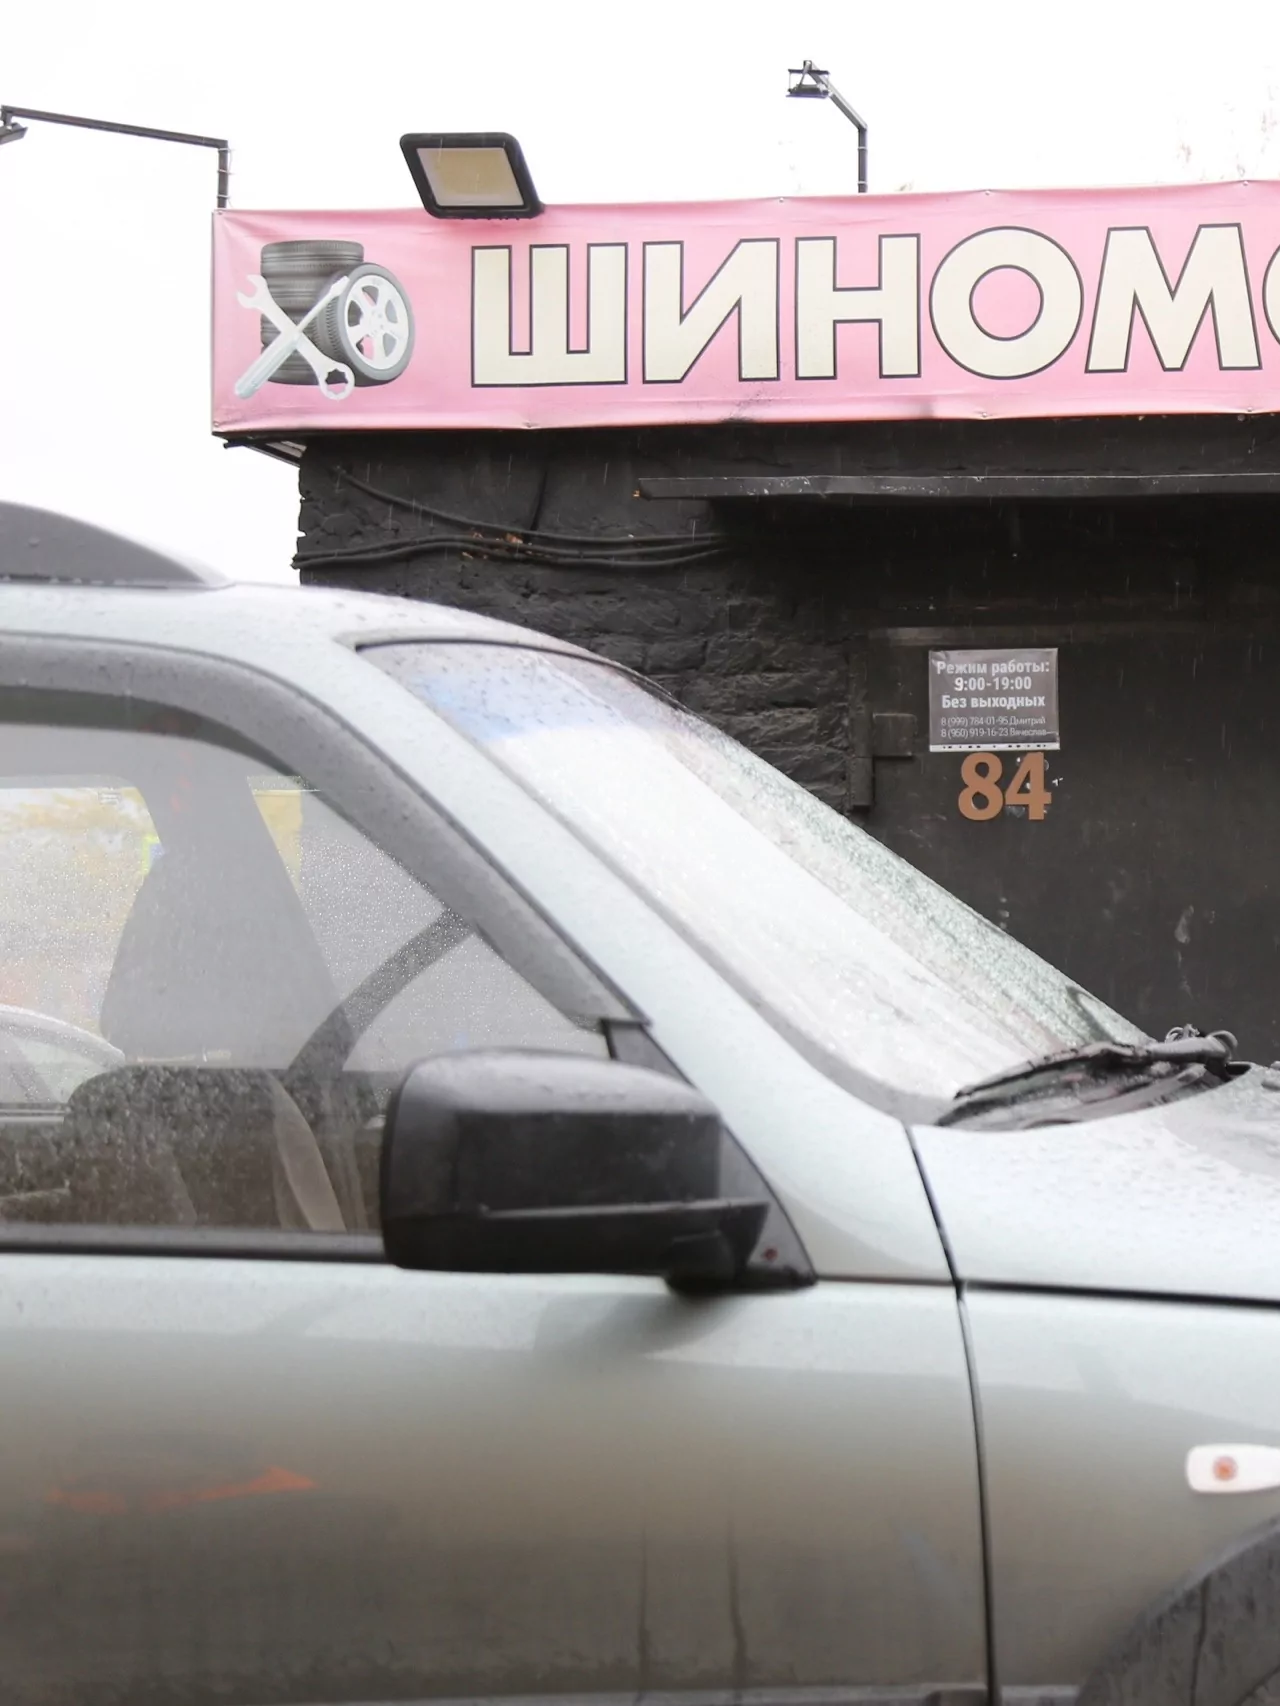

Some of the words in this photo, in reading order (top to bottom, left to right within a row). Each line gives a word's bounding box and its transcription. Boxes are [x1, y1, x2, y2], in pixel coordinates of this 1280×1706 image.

[936, 661, 987, 674] Режим
[991, 659, 1050, 676] работы:
[954, 676, 1032, 691] 9:00-19:00
[941, 694, 967, 709] Без
[970, 696, 1046, 710] выходных
[941, 717, 947, 726] 8
[1009, 715, 1046, 727] Дмитрий
[941, 728, 947, 738] 8
[958, 751, 1052, 821] 84
